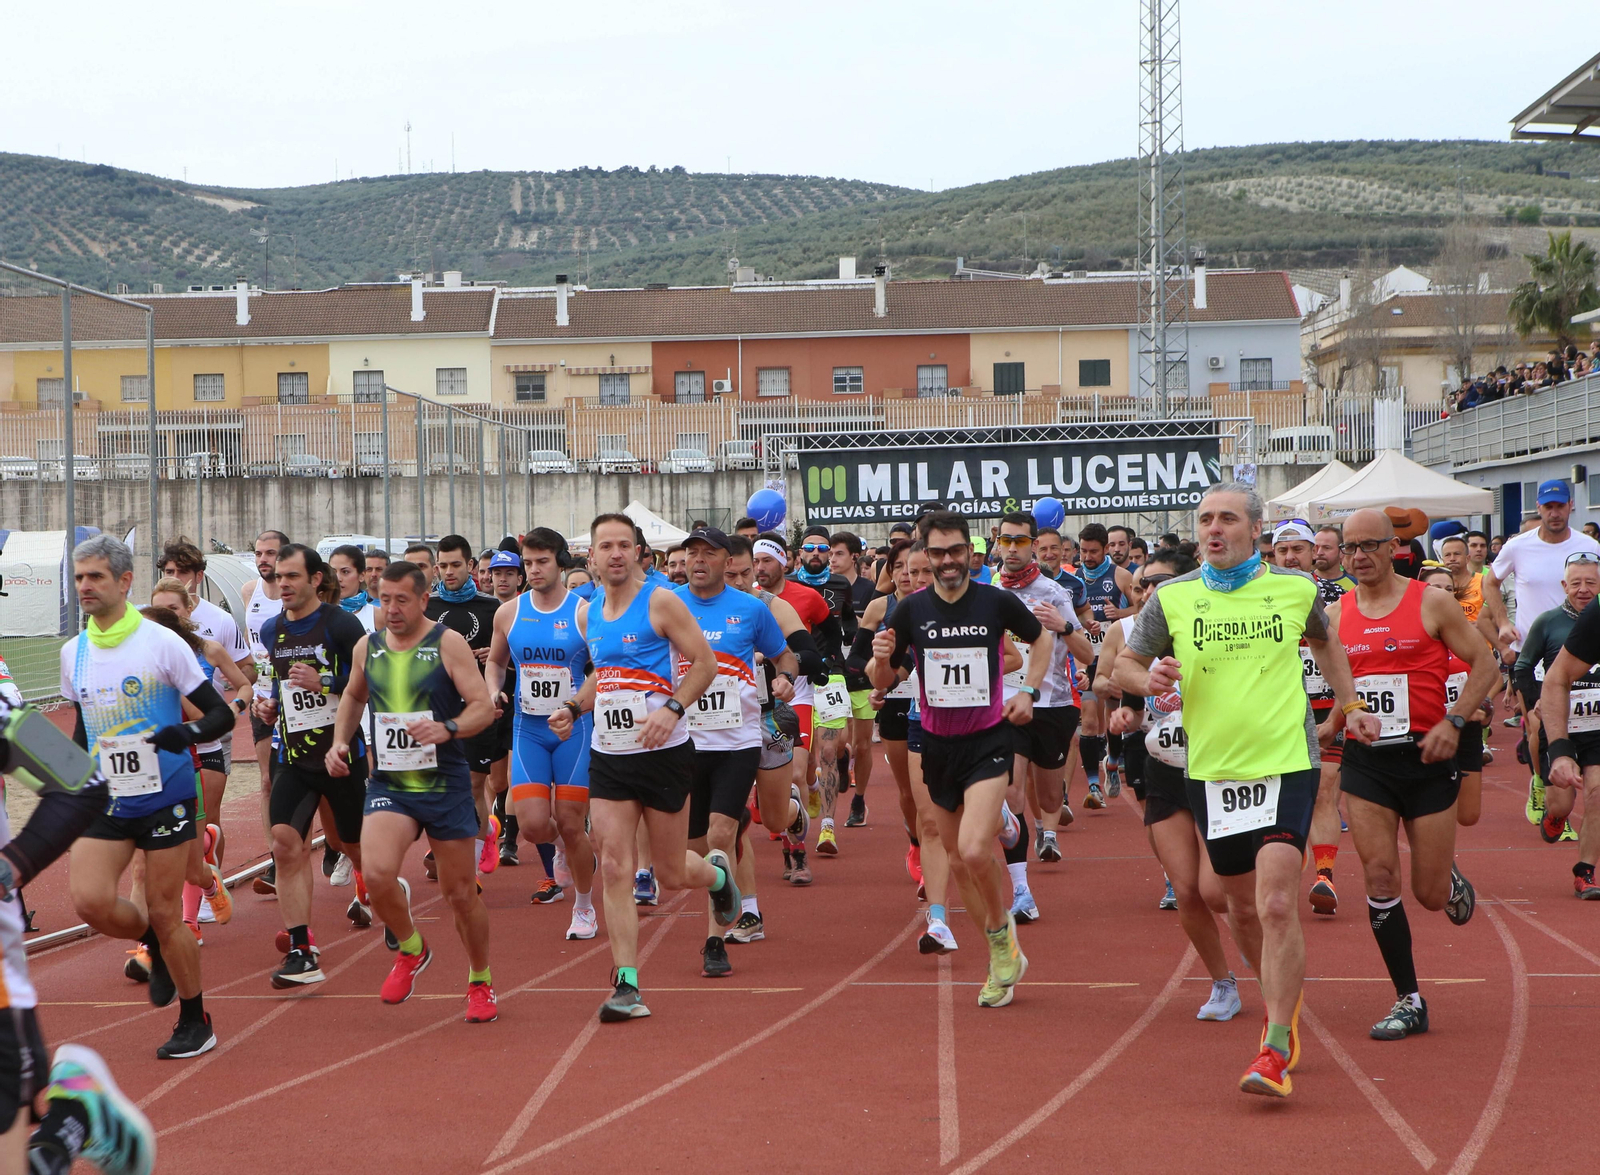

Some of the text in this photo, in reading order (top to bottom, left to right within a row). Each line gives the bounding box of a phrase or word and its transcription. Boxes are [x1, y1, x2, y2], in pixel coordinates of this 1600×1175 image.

[857, 451, 1211, 502] MILAR LUCENA
[808, 505, 876, 520] NUEVAS
[880, 499, 1001, 517] TECNOGÍAS
[1003, 498, 1020, 515] &
[927, 625, 988, 639] O BARCO
[523, 647, 566, 661] DAVID
[941, 663, 970, 685] 711
[531, 680, 560, 699] 987
[826, 691, 843, 706] 54
[292, 690, 327, 711] 953
[698, 691, 726, 712] 617
[1574, 700, 1600, 717] 414
[604, 708, 634, 730] 149
[109, 751, 140, 775] 178
[1222, 783, 1267, 813] 980
